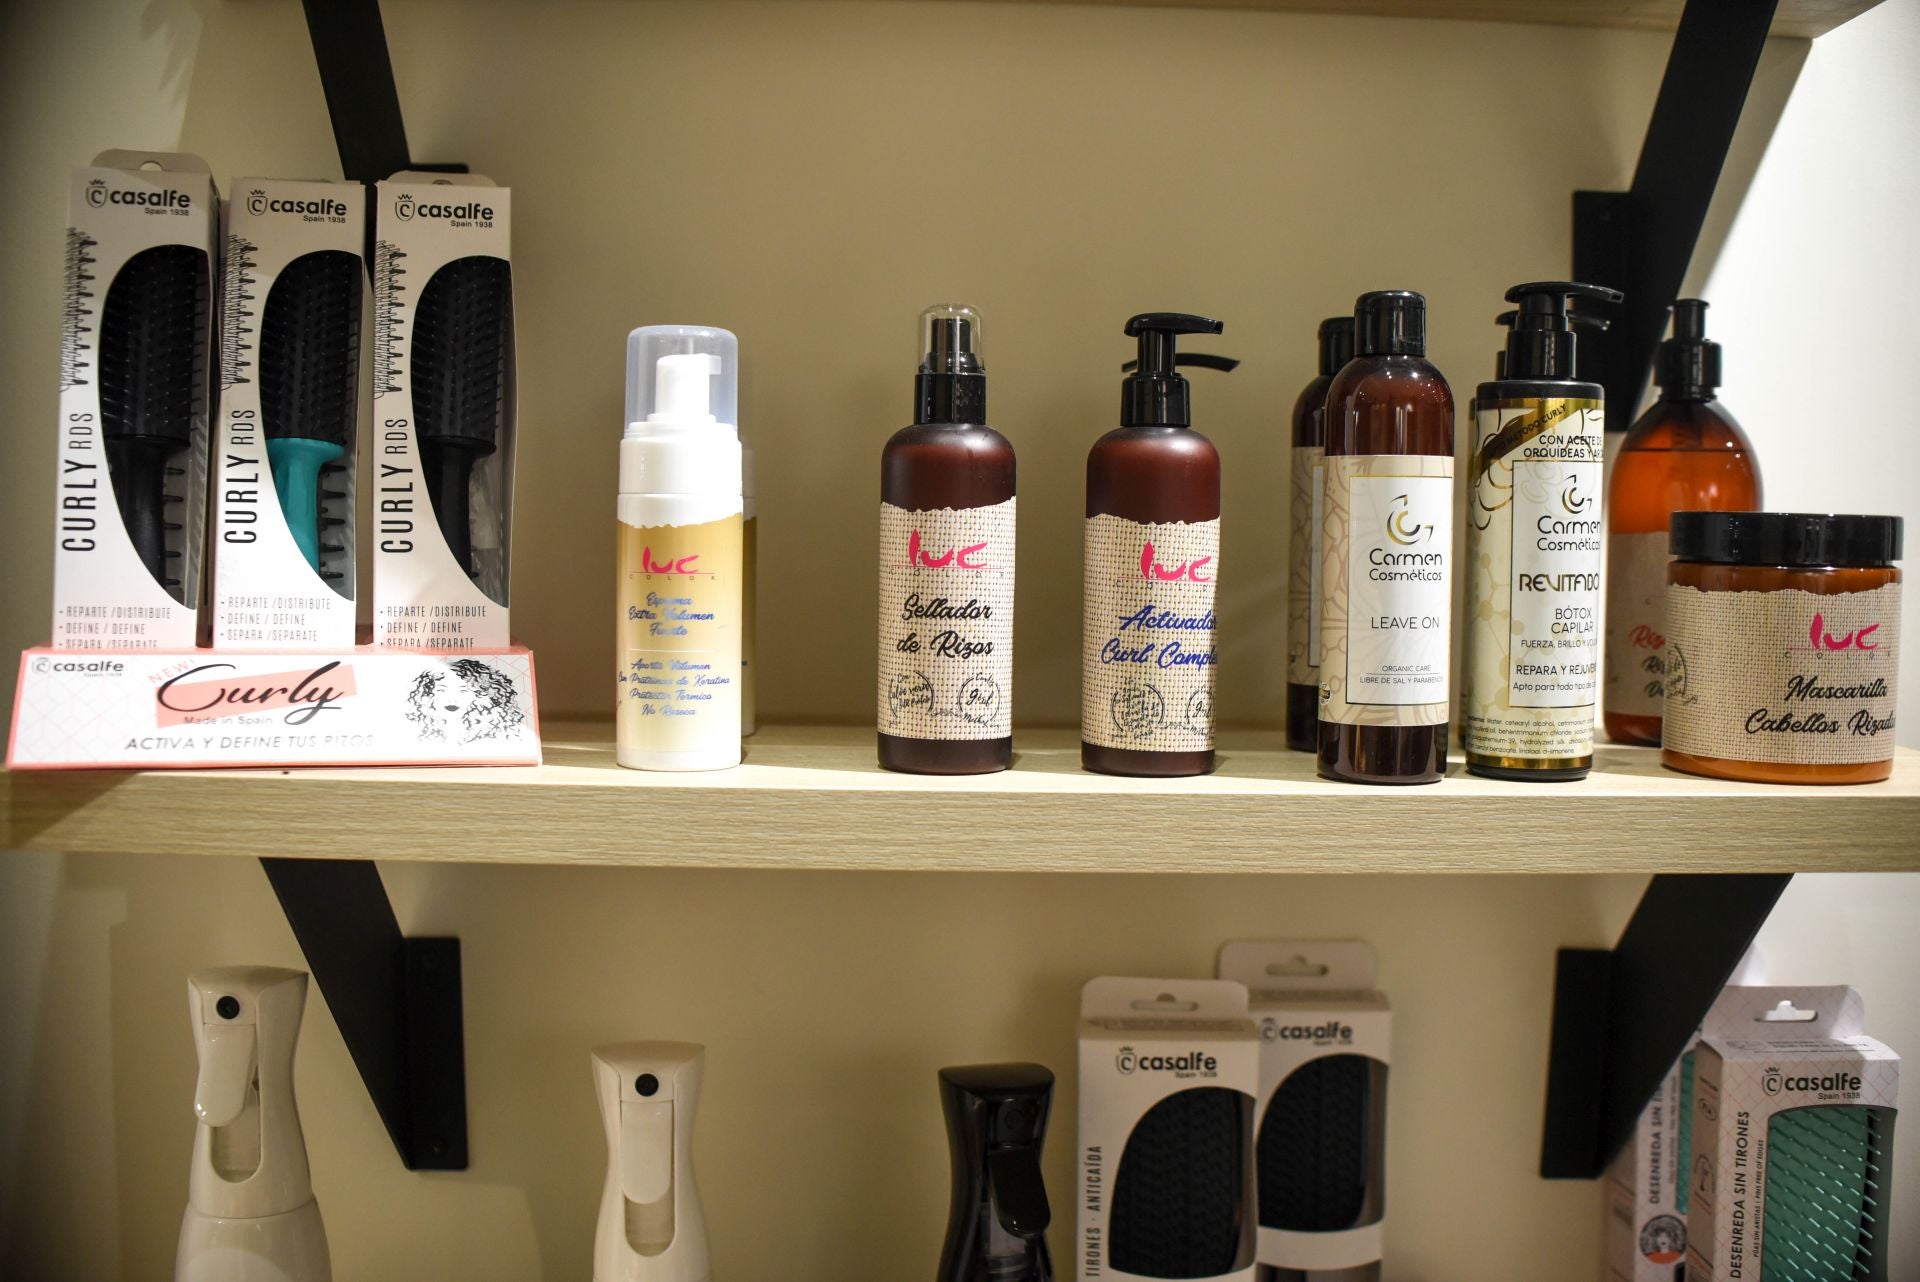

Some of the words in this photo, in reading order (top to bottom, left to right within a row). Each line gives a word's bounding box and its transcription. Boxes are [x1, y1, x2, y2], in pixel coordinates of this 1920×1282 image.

[110, 189, 191, 208] casalfe
[144, 207, 167, 216] Spain
[170, 208, 190, 217] 1938
[269, 199, 347, 216] casalfe
[418, 203, 494, 221] casalfe
[303, 215, 325, 223] Spain
[327, 216, 346, 224] 1938
[451, 220, 472, 228] Spain
[475, 221, 493, 229] 1938
[1541, 404, 1567, 423] CURLY
[69, 413, 93, 450] RDS
[231, 410, 255, 445] RDS
[385, 419, 408, 454] RDS
[1538, 435, 1563, 445] CON
[1523, 446, 1585, 458] ORQUÍDEAS
[62, 459, 97, 552] CURLY
[224, 454, 259, 543] CURLY
[381, 464, 413, 553] CURLY
[908, 528, 989, 569] luc
[1369, 548, 1443, 566] Carmen
[1369, 568, 1442, 582] Cosméticos
[228, 597, 268, 608] REPARTE
[901, 593, 993, 621] Sellador
[66, 606, 107, 618] REPARTE
[227, 613, 260, 624] DEFINE
[273, 614, 305, 626] DEFINE
[387, 606, 425, 617] REPARTE
[1555, 605, 1592, 620] BÓTOX
[66, 623, 101, 634] DEFINE
[112, 624, 145, 635] DEFINE
[387, 622, 421, 633] DEFINE
[431, 622, 462, 634] DEFINE
[1371, 616, 1417, 629] LEAVE
[1422, 616, 1440, 629] ON
[1551, 622, 1593, 634] CAPILAR
[227, 630, 263, 641] SEPARA
[1521, 640, 1555, 648] FUERZA,
[1557, 640, 1581, 648] BRILLO
[897, 632, 921, 654] de
[930, 630, 994, 659] Rizos
[1101, 637, 1155, 664] Curl
[53, 660, 124, 672] casalfe
[1381, 665, 1414, 673] ORGANIC
[1516, 664, 1557, 676] REPARA
[1560, 665, 1567, 676] Y
[1360, 676, 1379, 684] LIBRE
[1513, 682, 1533, 692] Apto
[1535, 683, 1555, 692] para
[1557, 683, 1573, 691] todo
[1784, 674, 1888, 701] Mascarilla
[157, 661, 343, 725] Curly
[184, 716, 217, 725] Made
[221, 716, 233, 725] in
[238, 715, 273, 726] Spain
[1745, 708, 1840, 734] Cabellos
[125, 737, 195, 750] ACTIVA
[203, 737, 215, 749] Y
[220, 736, 280, 750] DEFINE
[288, 735, 317, 748] TUS
[1280, 1021, 1353, 1039] casalfe
[1139, 1051, 1217, 1071] casalfe
[1784, 1073, 1861, 1091] casalfe
[1818, 1092, 1840, 1100] Spain
[1842, 1092, 1861, 1100] 1938
[1736, 1111, 1750, 1168] TIRONES
[1649, 1132, 1662, 1204] DESENREDA
[1084, 1146, 1102, 1211] ANTICAÍDA
[1734, 1172, 1747, 1195] SIN
[1730, 1199, 1745, 1279] DESENREDA
[1086, 1227, 1102, 1277] TIRONES
